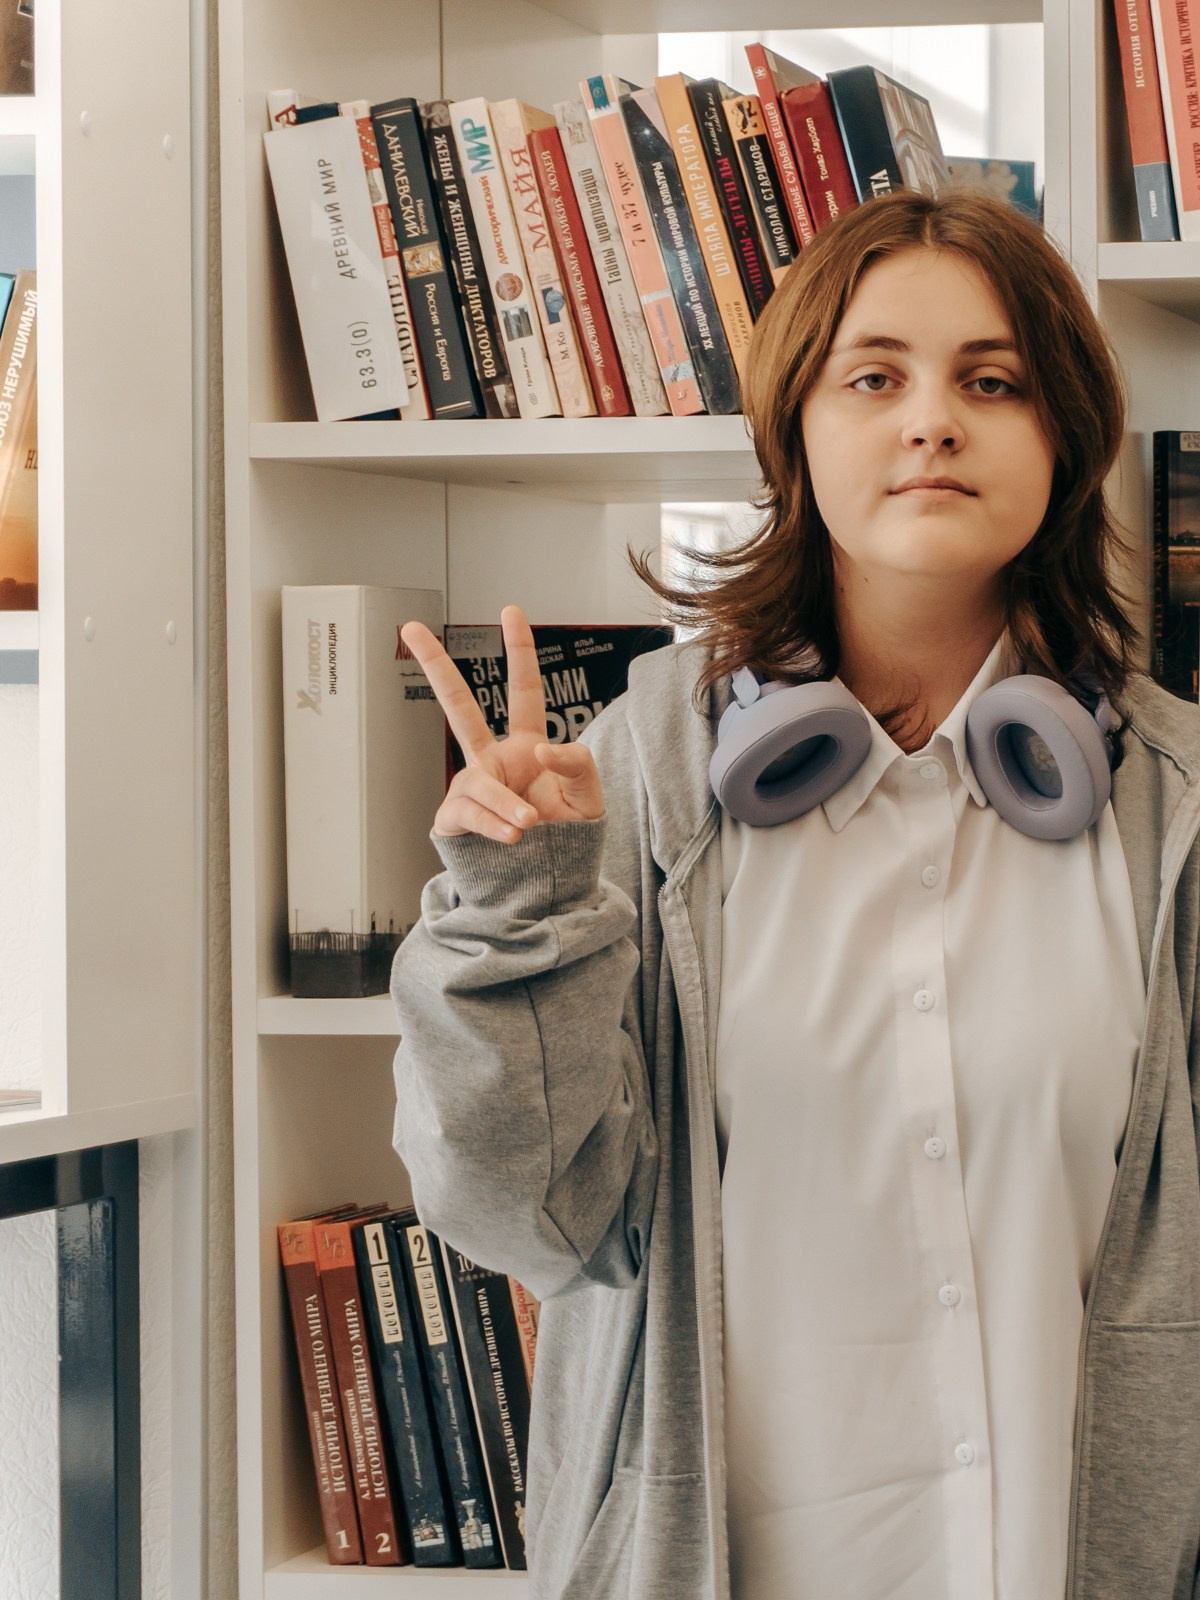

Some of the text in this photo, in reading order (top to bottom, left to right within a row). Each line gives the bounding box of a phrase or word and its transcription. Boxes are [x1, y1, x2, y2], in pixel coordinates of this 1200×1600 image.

[1130, 35, 1144, 87] ИСТОРИЯ
[1182, 48, 1196, 88] КРИТИКА
[461, 118, 492, 172] МИР
[764, 102, 795, 183] СУДЬБЫ ВЕЩЕЙ
[1186, 93, 1200, 128] РОССИЯ:
[384, 125, 426, 236] ДАНИЛЕВСКИЙ
[510, 148, 552, 249] МАЙЯ
[614, 161, 646, 246] 7 и 37 чудес
[677, 124, 730, 276] ШЛЯПА ИМПЕРАТОРА
[749, 142, 788, 256] НИКОЛАЙ СТАРИКОВ
[816, 153, 828, 180] Томас
[317, 158, 356, 278] ДРЕВНИЙ МИР
[434, 134, 496, 377] ЖЕНЫ И ЖЕНЩИНЫ ДИКТАТОРОВ
[540, 150, 602, 368] ЛЮБОВНЫЕ ПИСЬМА ВЕЛИКИХ ЛЮДЕЙ
[580, 168, 621, 284] Тайны цивилизаций
[652, 161, 710, 337] ЛЕКЦИЙ ПО ИСТОРИИ МИРОВОЙ КУЛЬТУРЫ
[3, 289, 40, 397] НЕРУШИМЫЙ
[348, 321, 376, 388] 63.3(0)
[424, 282, 450, 380] Россия и Европа
[559, 348, 569, 360] М.
[297, 618, 322, 716] ХОЛОКОСТ
[328, 623, 338, 696] ЭНЦИКЛОПЕДИЯ
[471, 658, 502, 685] ЗА
[574, 637, 594, 648] ИЛЬЯ
[576, 642, 613, 657] ВАСИЛЬЕВ
[372, 1231, 384, 1261] 1
[413, 1233, 428, 1263] 2
[379, 1271, 398, 1335] ИСТОРИЯ
[422, 1269, 443, 1337] ИСТОРИЯ
[305, 1294, 345, 1492] ИСТОРИЯ ДРЕВНЕГО МИРА
[344, 1298, 385, 1497] ИСТОРИЯ ДРЕВНЕГО МИРА
[477, 1287, 523, 1491] РАССКАЗЫ ПО ИСТОРИИ ДРЕВНЕГО МИРА
[312, 1410, 331, 1493] А. И. Немировский
[345, 1389, 370, 1500] А. И. Немировский
[336, 1529, 351, 1549] 1
[376, 1532, 391, 1554] 2
